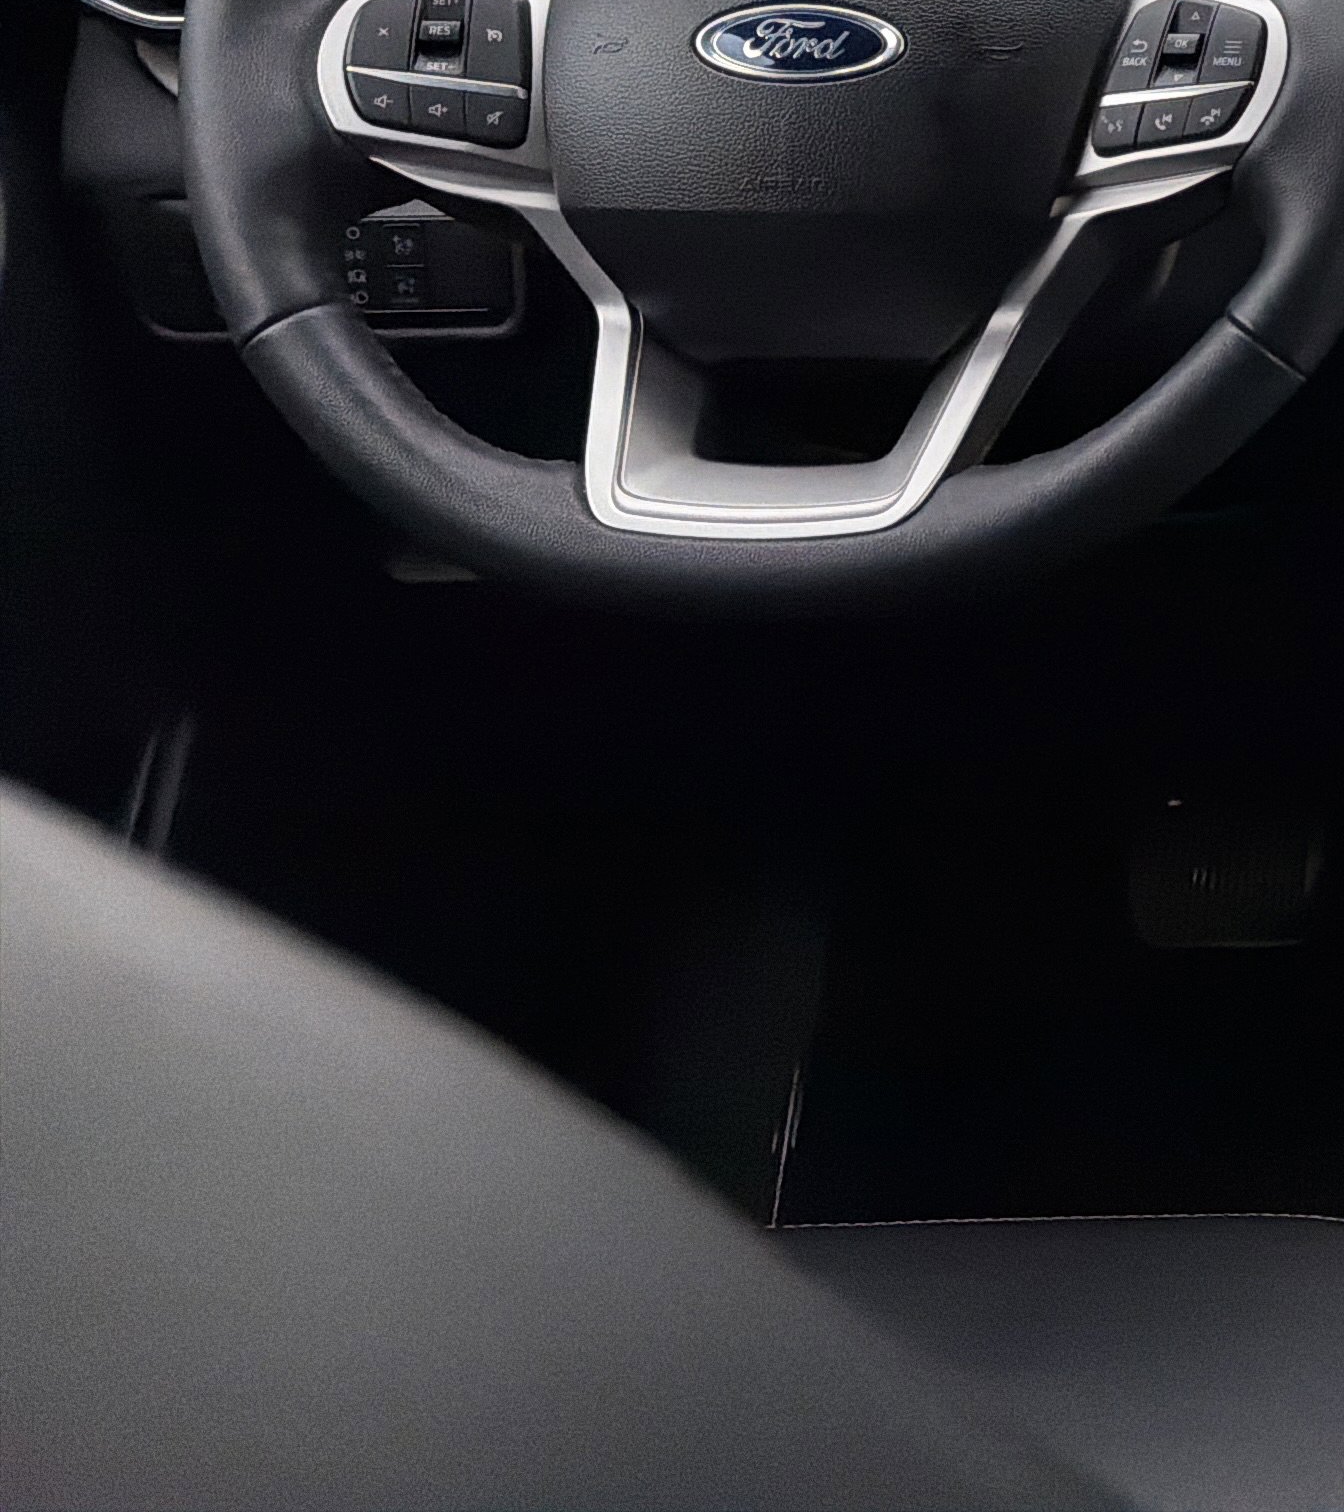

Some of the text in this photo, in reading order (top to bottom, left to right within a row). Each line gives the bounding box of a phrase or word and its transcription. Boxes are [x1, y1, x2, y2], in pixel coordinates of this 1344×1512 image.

[428, 25, 450, 36] RES
[742, 18, 850, 60] Ford
[1174, 39, 1188, 48] OK
[1121, 56, 1147, 67] BACK
[1212, 56, 1242, 67] MENU
